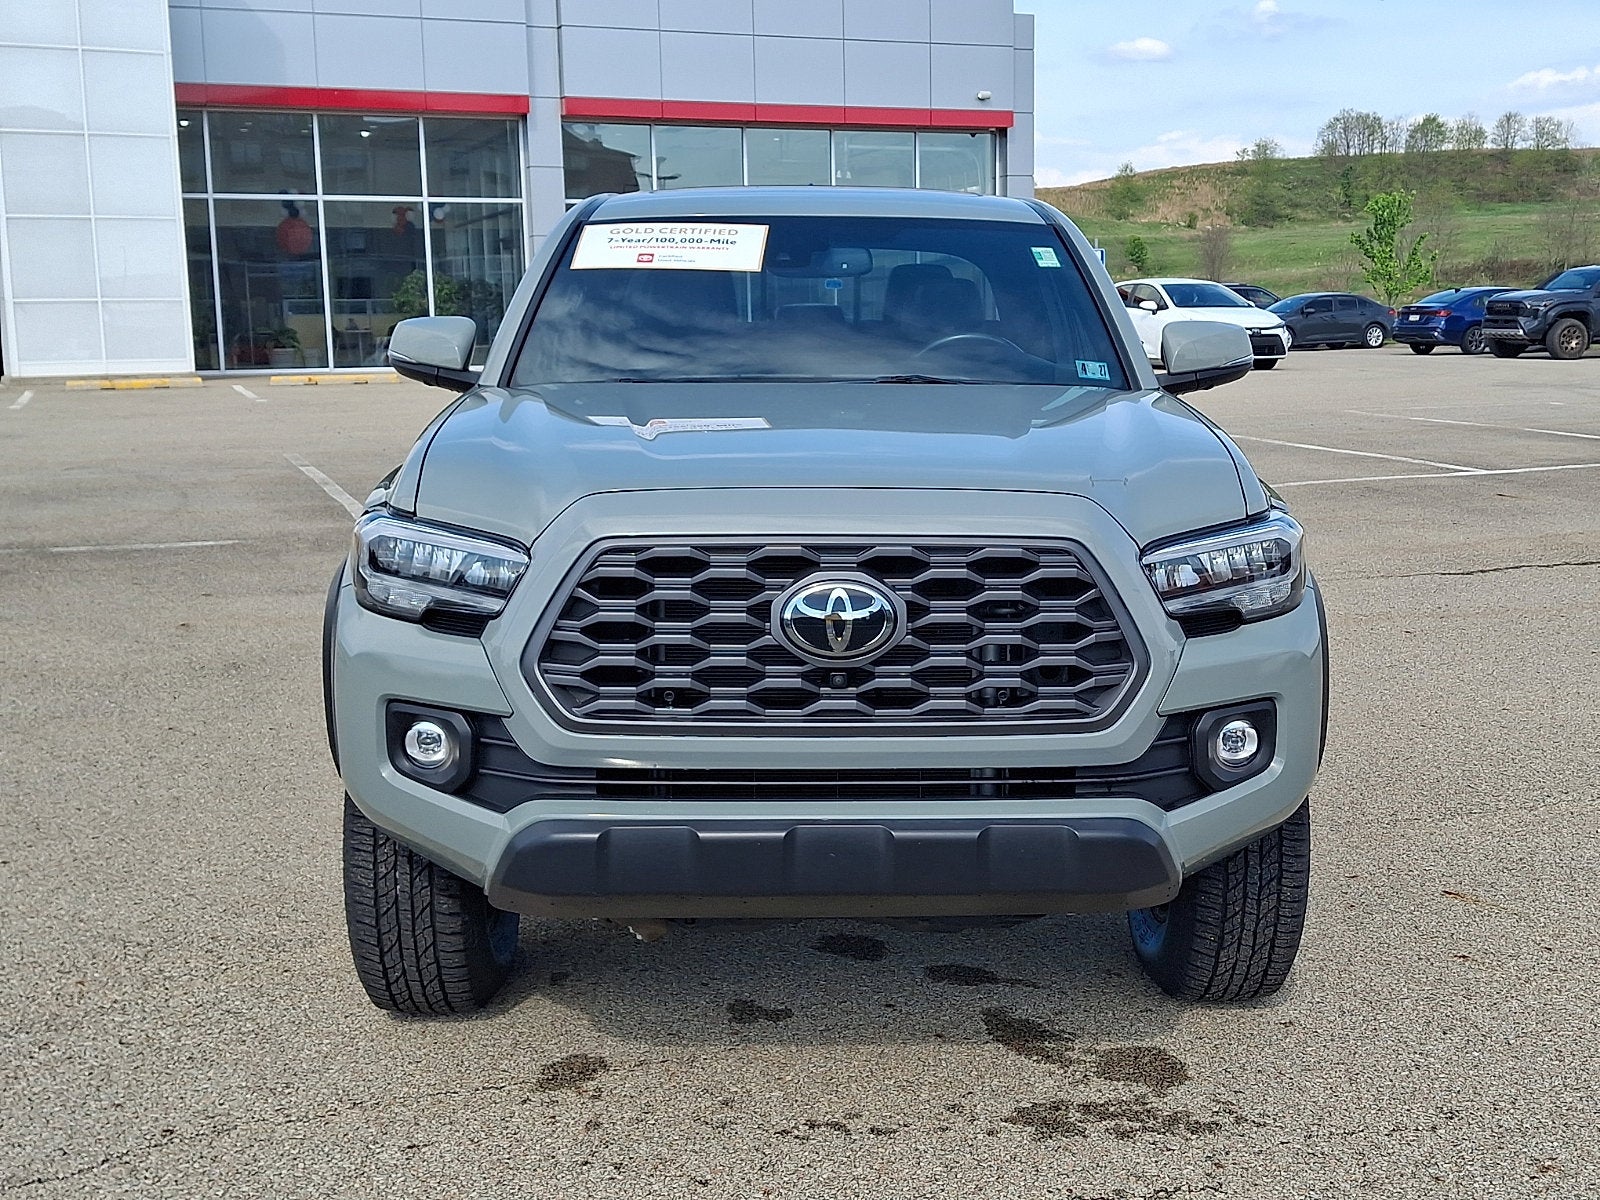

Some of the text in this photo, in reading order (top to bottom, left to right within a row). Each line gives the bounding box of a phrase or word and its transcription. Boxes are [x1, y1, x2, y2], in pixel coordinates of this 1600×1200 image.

[609, 227, 739, 236] GOLD CERTIFIED
[607, 236, 737, 246] 7-Year/100,000-Mile
